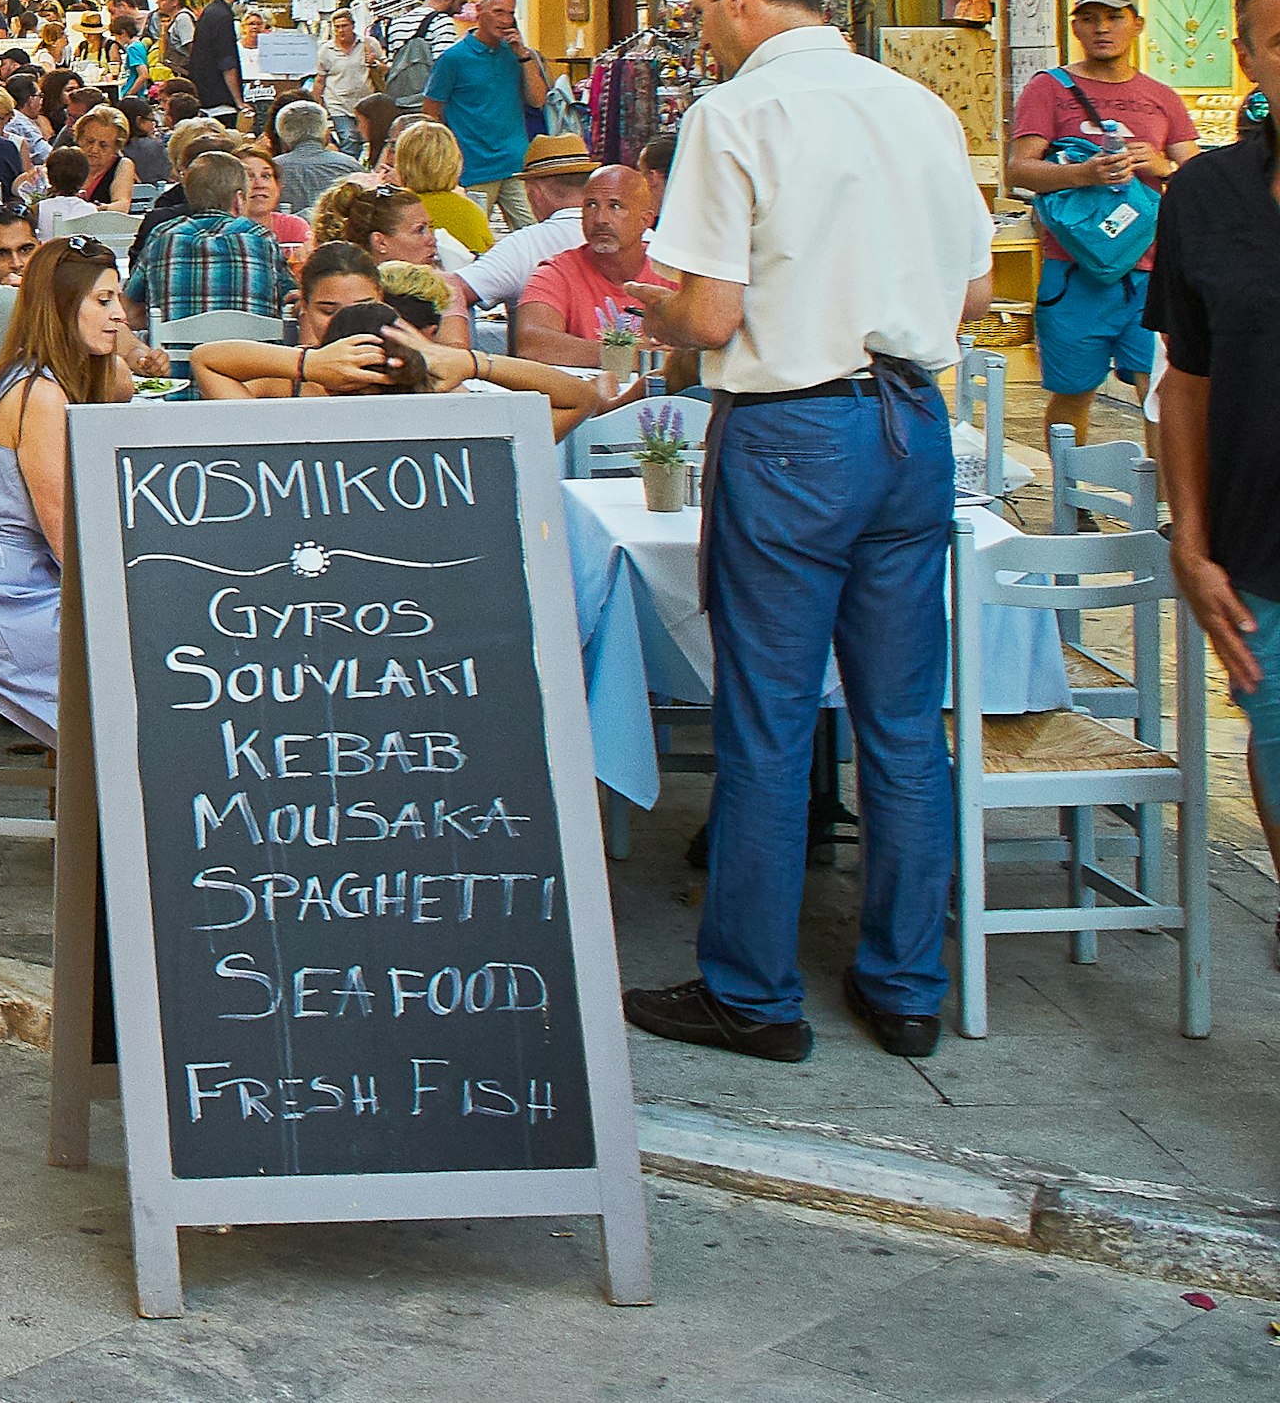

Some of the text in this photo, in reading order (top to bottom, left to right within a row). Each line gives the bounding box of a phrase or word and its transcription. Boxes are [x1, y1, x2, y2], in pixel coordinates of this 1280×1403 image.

[123, 447, 477, 529] KOSMIKON
[208, 587, 435, 639] GYROS
[165, 644, 478, 711] SOUVLAKI
[222, 719, 468, 781] KEBAB
[193, 793, 531, 849] MOUSAKA
[192, 865, 557, 930] SPAGHETTI
[185, 1058, 559, 1125] FRESH FISH
